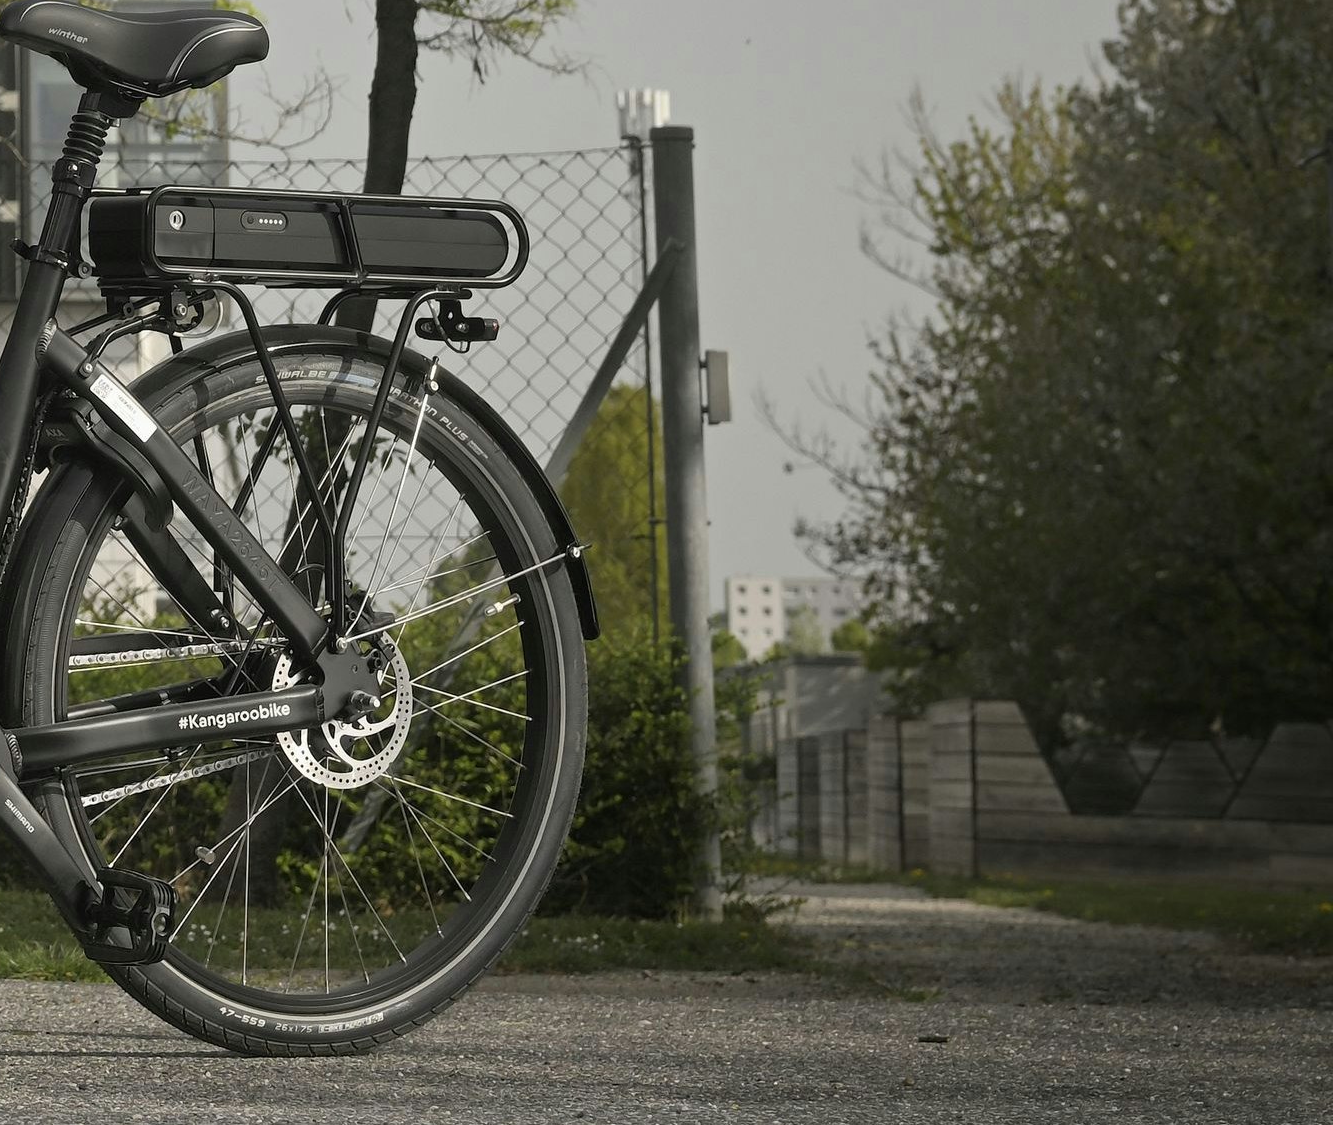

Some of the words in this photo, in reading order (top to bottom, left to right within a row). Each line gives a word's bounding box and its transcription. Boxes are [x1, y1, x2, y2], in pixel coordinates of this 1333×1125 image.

[255, 370, 327, 384] SHWALBE
[439, 416, 469, 446] PLUS
[178, 702, 291, 730] #Kangaroobike
[4, 798, 35, 835] SHIMANO
[219, 1006, 266, 1028] 47-559
